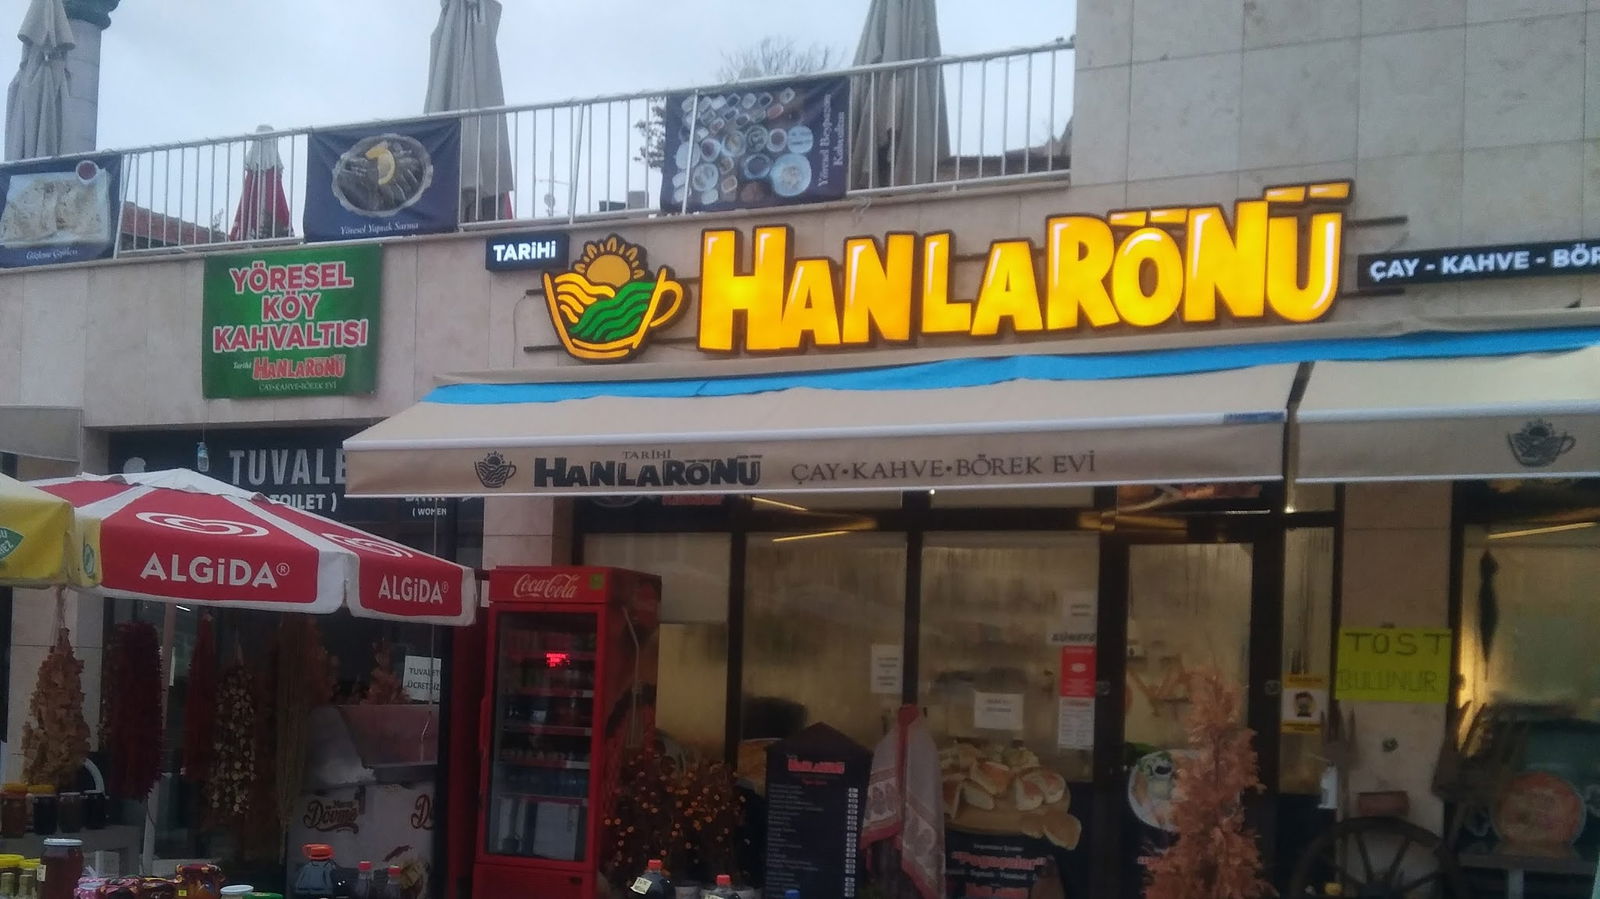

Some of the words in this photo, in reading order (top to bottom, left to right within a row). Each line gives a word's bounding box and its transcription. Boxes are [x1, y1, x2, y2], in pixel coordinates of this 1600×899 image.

[229, 261, 354, 294] YÖRESEL
[699, 181, 1351, 351] HANLARÖNÜ
[1369, 258, 1419, 282] ÇAY
[1442, 251, 1530, 275] KAHVE
[262, 290, 320, 322] KÖY
[212, 320, 369, 352] KAHVALTISI
[252, 354, 347, 380] HANLARÖNÜ
[534, 455, 762, 487] HANLARÖNÜ
[1053, 450, 1096, 473] EVİ
[1345, 632, 1451, 656] TOST
